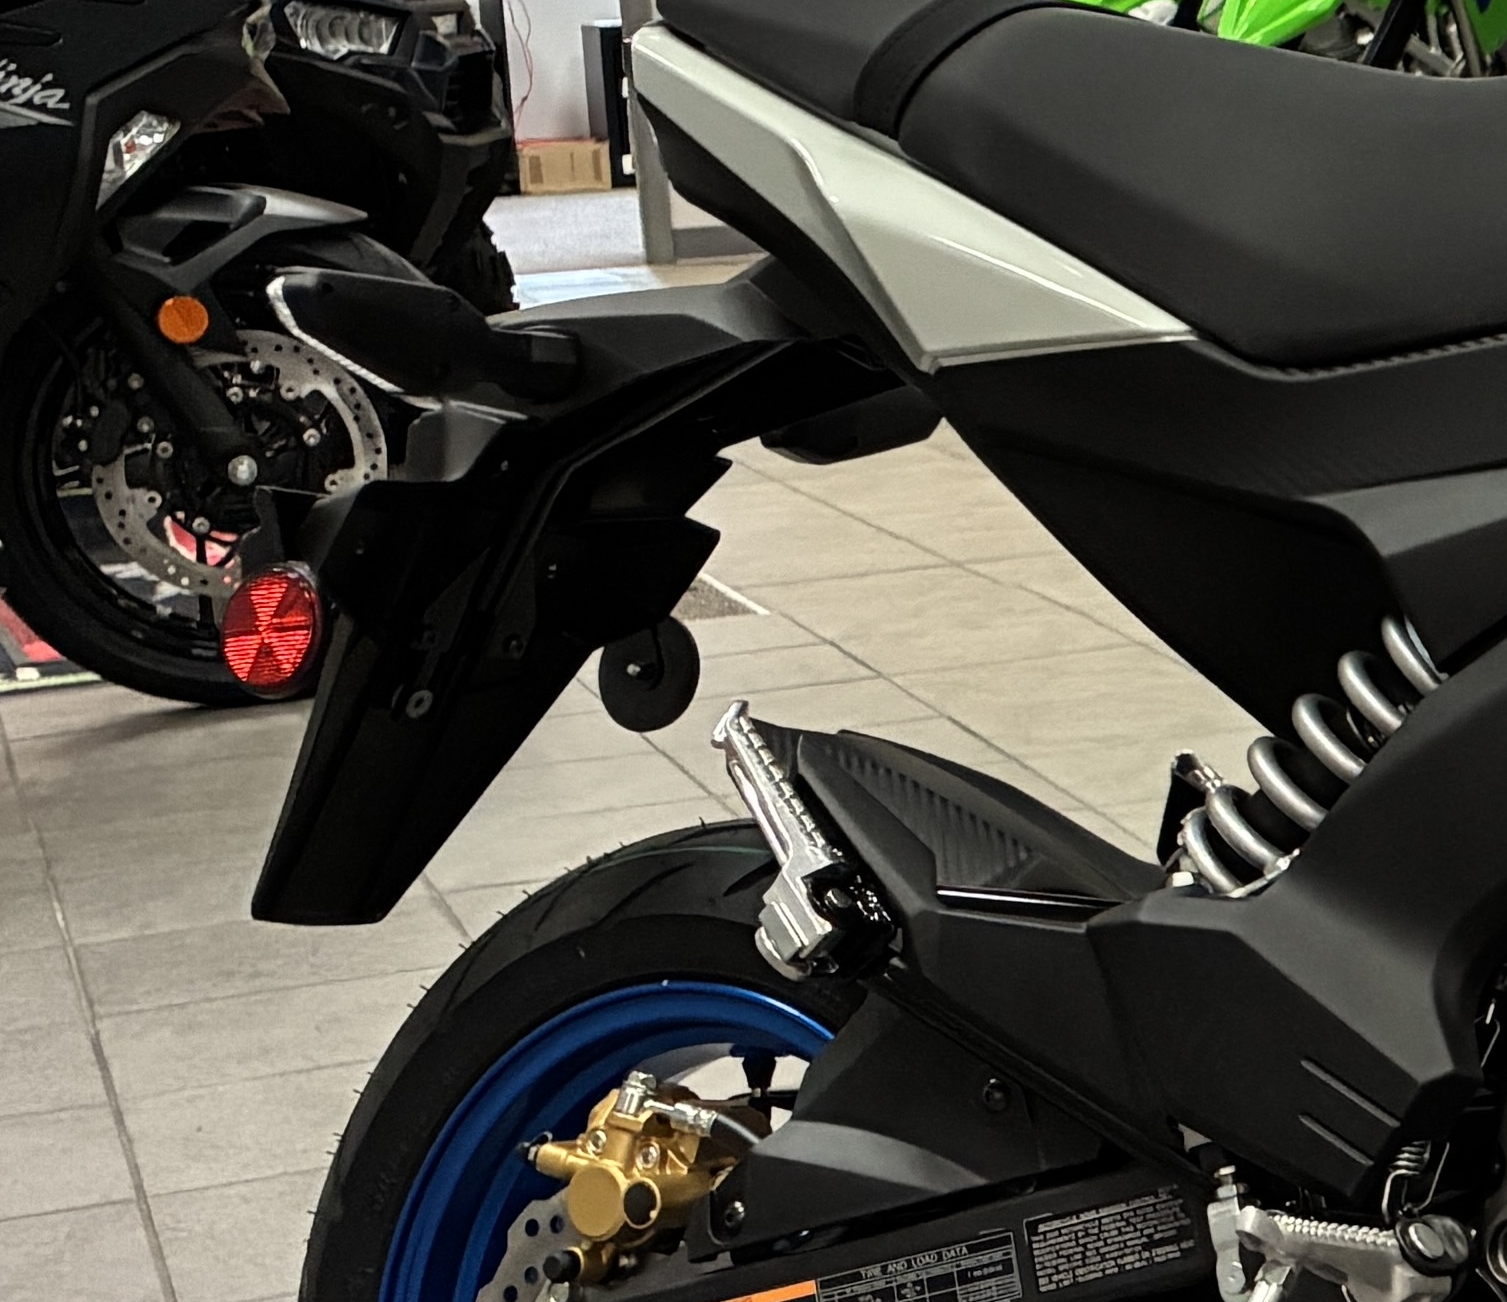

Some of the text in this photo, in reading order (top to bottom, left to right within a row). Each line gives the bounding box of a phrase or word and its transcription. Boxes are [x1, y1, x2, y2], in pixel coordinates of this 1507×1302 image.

[887, 1259, 908, 1276] AND
[911, 1252, 938, 1269] LOAD
[942, 1245, 969, 1262] DATA
